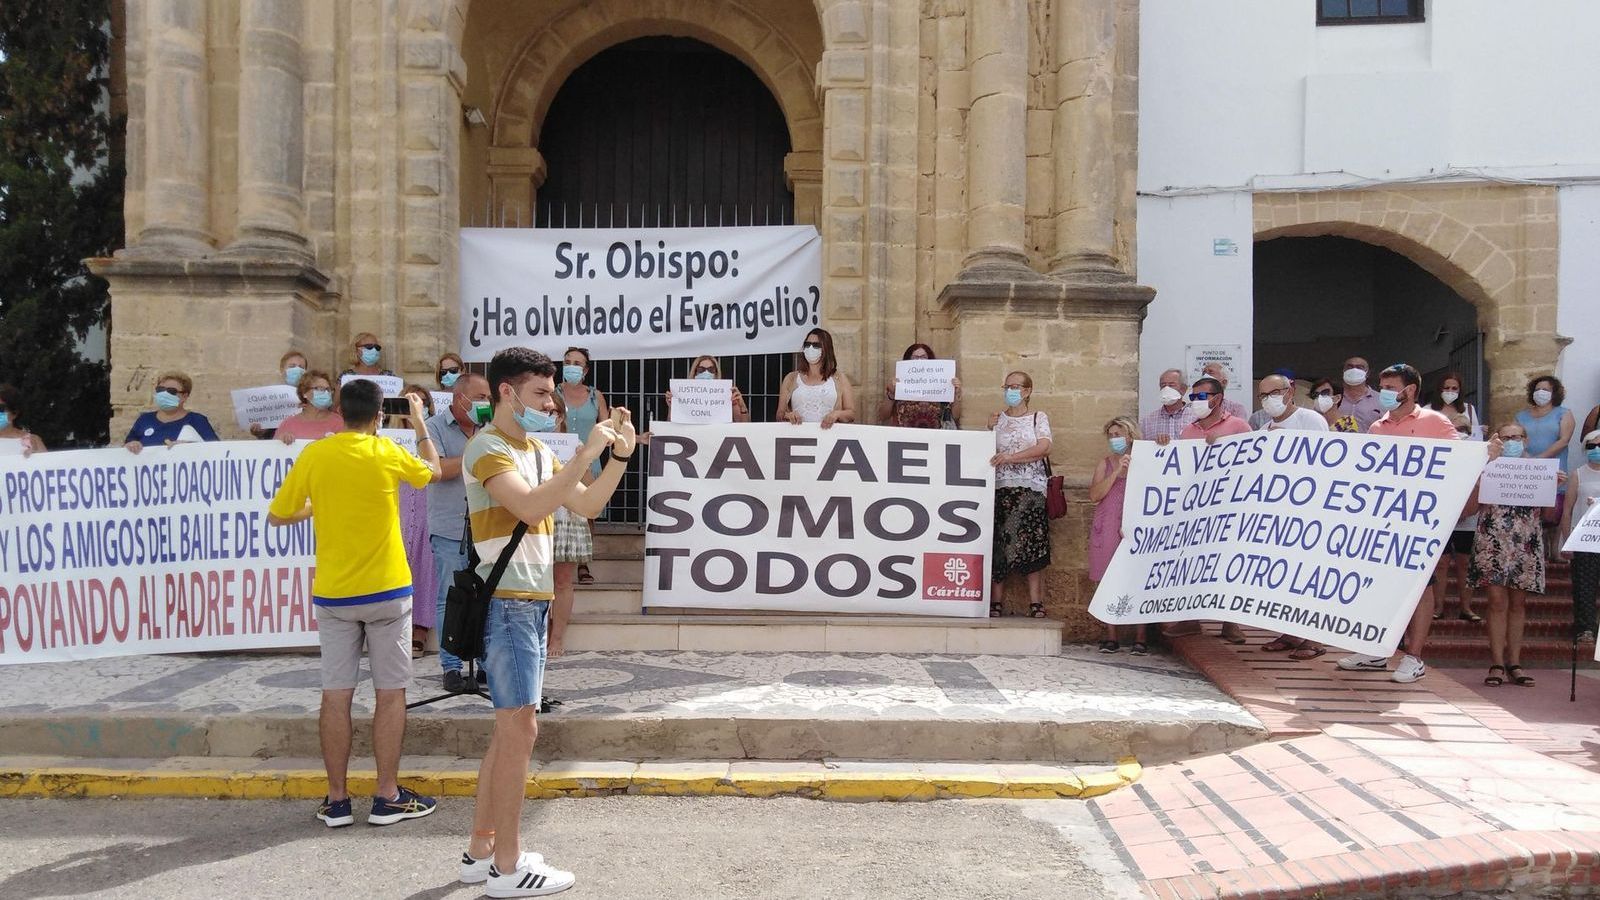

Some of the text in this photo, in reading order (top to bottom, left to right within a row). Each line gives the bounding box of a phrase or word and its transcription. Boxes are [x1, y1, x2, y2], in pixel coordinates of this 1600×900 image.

[554, 240, 739, 289] Sr. Obispo:
[470, 285, 820, 347] ¿Ha olvidado el Evangelio?
[5, 466, 128, 516] PROFESORES
[133, 463, 167, 508] JOSE
[170, 450, 241, 507] JOAQUÍN
[246, 459, 256, 500] Y
[649, 435, 987, 487] RAFAEL
[1192, 435, 1263, 475] VECES
[1273, 436, 1348, 467] UNO
[1355, 441, 1452, 480] SABE
[647, 491, 982, 543] SOMOS
[1142, 469, 1440, 530] DE QUÉ LADO ESTAR,
[16, 522, 55, 573] LOS
[61, 518, 145, 570] AMIGOS
[147, 516, 176, 564] DEL
[180, 512, 229, 561] BAILE
[235, 511, 259, 559] DE
[1130, 512, 1237, 555] SIMPLEMENTE
[1237, 513, 1321, 551] VIENDO
[646, 547, 917, 599] TODOS
[927, 586, 981, 598] Cáritas
[1144, 551, 1190, 591] ESTÁN
[1190, 553, 1221, 585] DEL
[1226, 554, 1288, 590] OTRO
[138, 576, 162, 641] AL
[165, 570, 235, 639] PADRE
[1139, 594, 1186, 615] CONSEJO
[1186, 594, 1226, 610] LOCAL
[1229, 596, 1255, 613] DE
